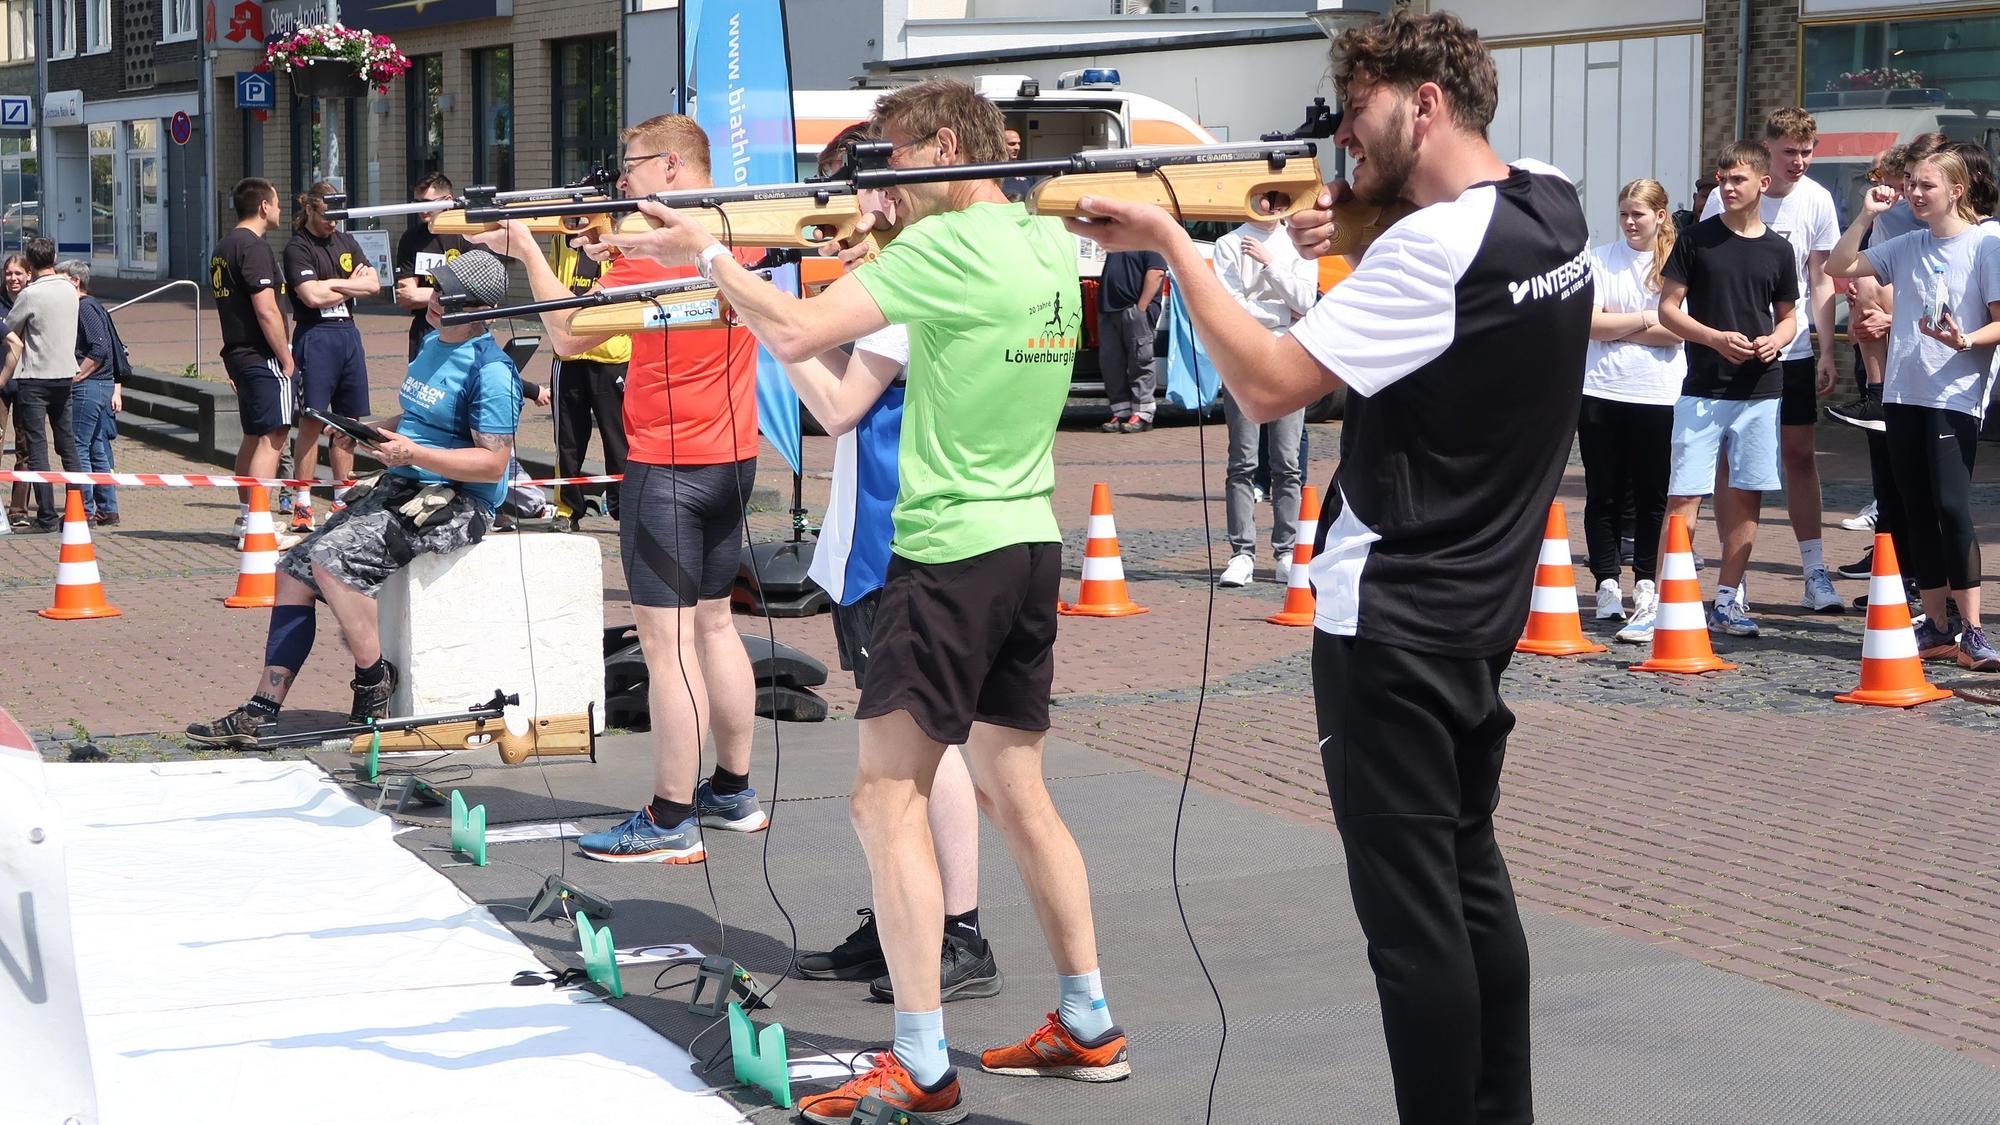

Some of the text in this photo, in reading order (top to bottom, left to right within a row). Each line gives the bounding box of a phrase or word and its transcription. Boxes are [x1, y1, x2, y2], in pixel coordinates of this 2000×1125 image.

[270, 1, 342, 35] Stern-Apothe
[728, 12, 751, 187] www.biathlo
[684, 307, 713, 318] TOUR
